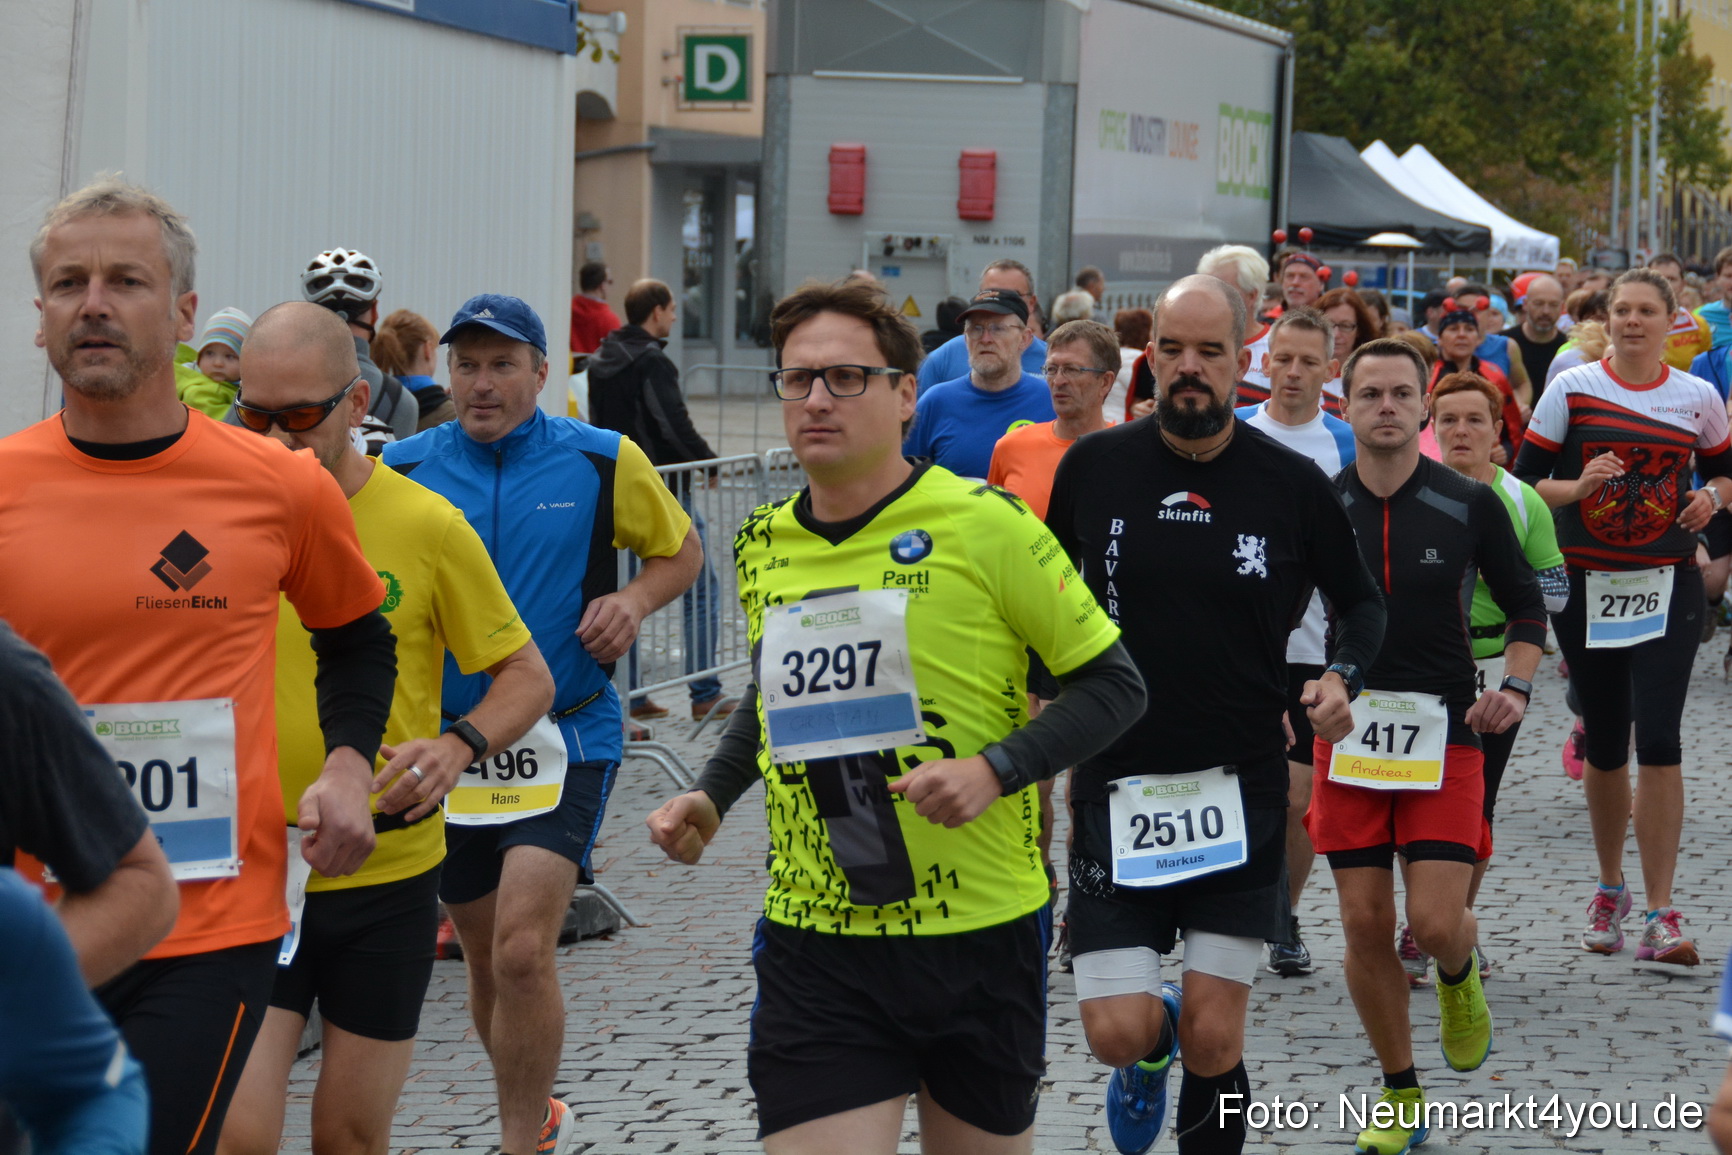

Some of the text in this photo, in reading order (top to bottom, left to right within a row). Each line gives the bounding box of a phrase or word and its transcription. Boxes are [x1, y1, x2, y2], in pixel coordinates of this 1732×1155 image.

[694, 44, 741, 93] D
[1217, 103, 1271, 198] BOCK
[1651, 406, 1694, 418] NEUMARKT
[1158, 508, 1212, 523] skinfit
[882, 570, 930, 586] Partl
[136, 596, 228, 610] FliesenEichl
[1600, 591, 1660, 618] 2726
[814, 609, 862, 626] BOCK
[782, 639, 883, 698] 3297
[1378, 699, 1416, 711] BOCK
[114, 719, 182, 736] BOCK
[1360, 721, 1421, 755] 417
[1351, 760, 1413, 779] Andreas
[1156, 781, 1201, 796] BOCK
[491, 793, 521, 805] Hans
[1129, 805, 1225, 851] 2510
[1155, 853, 1205, 870] Markus
